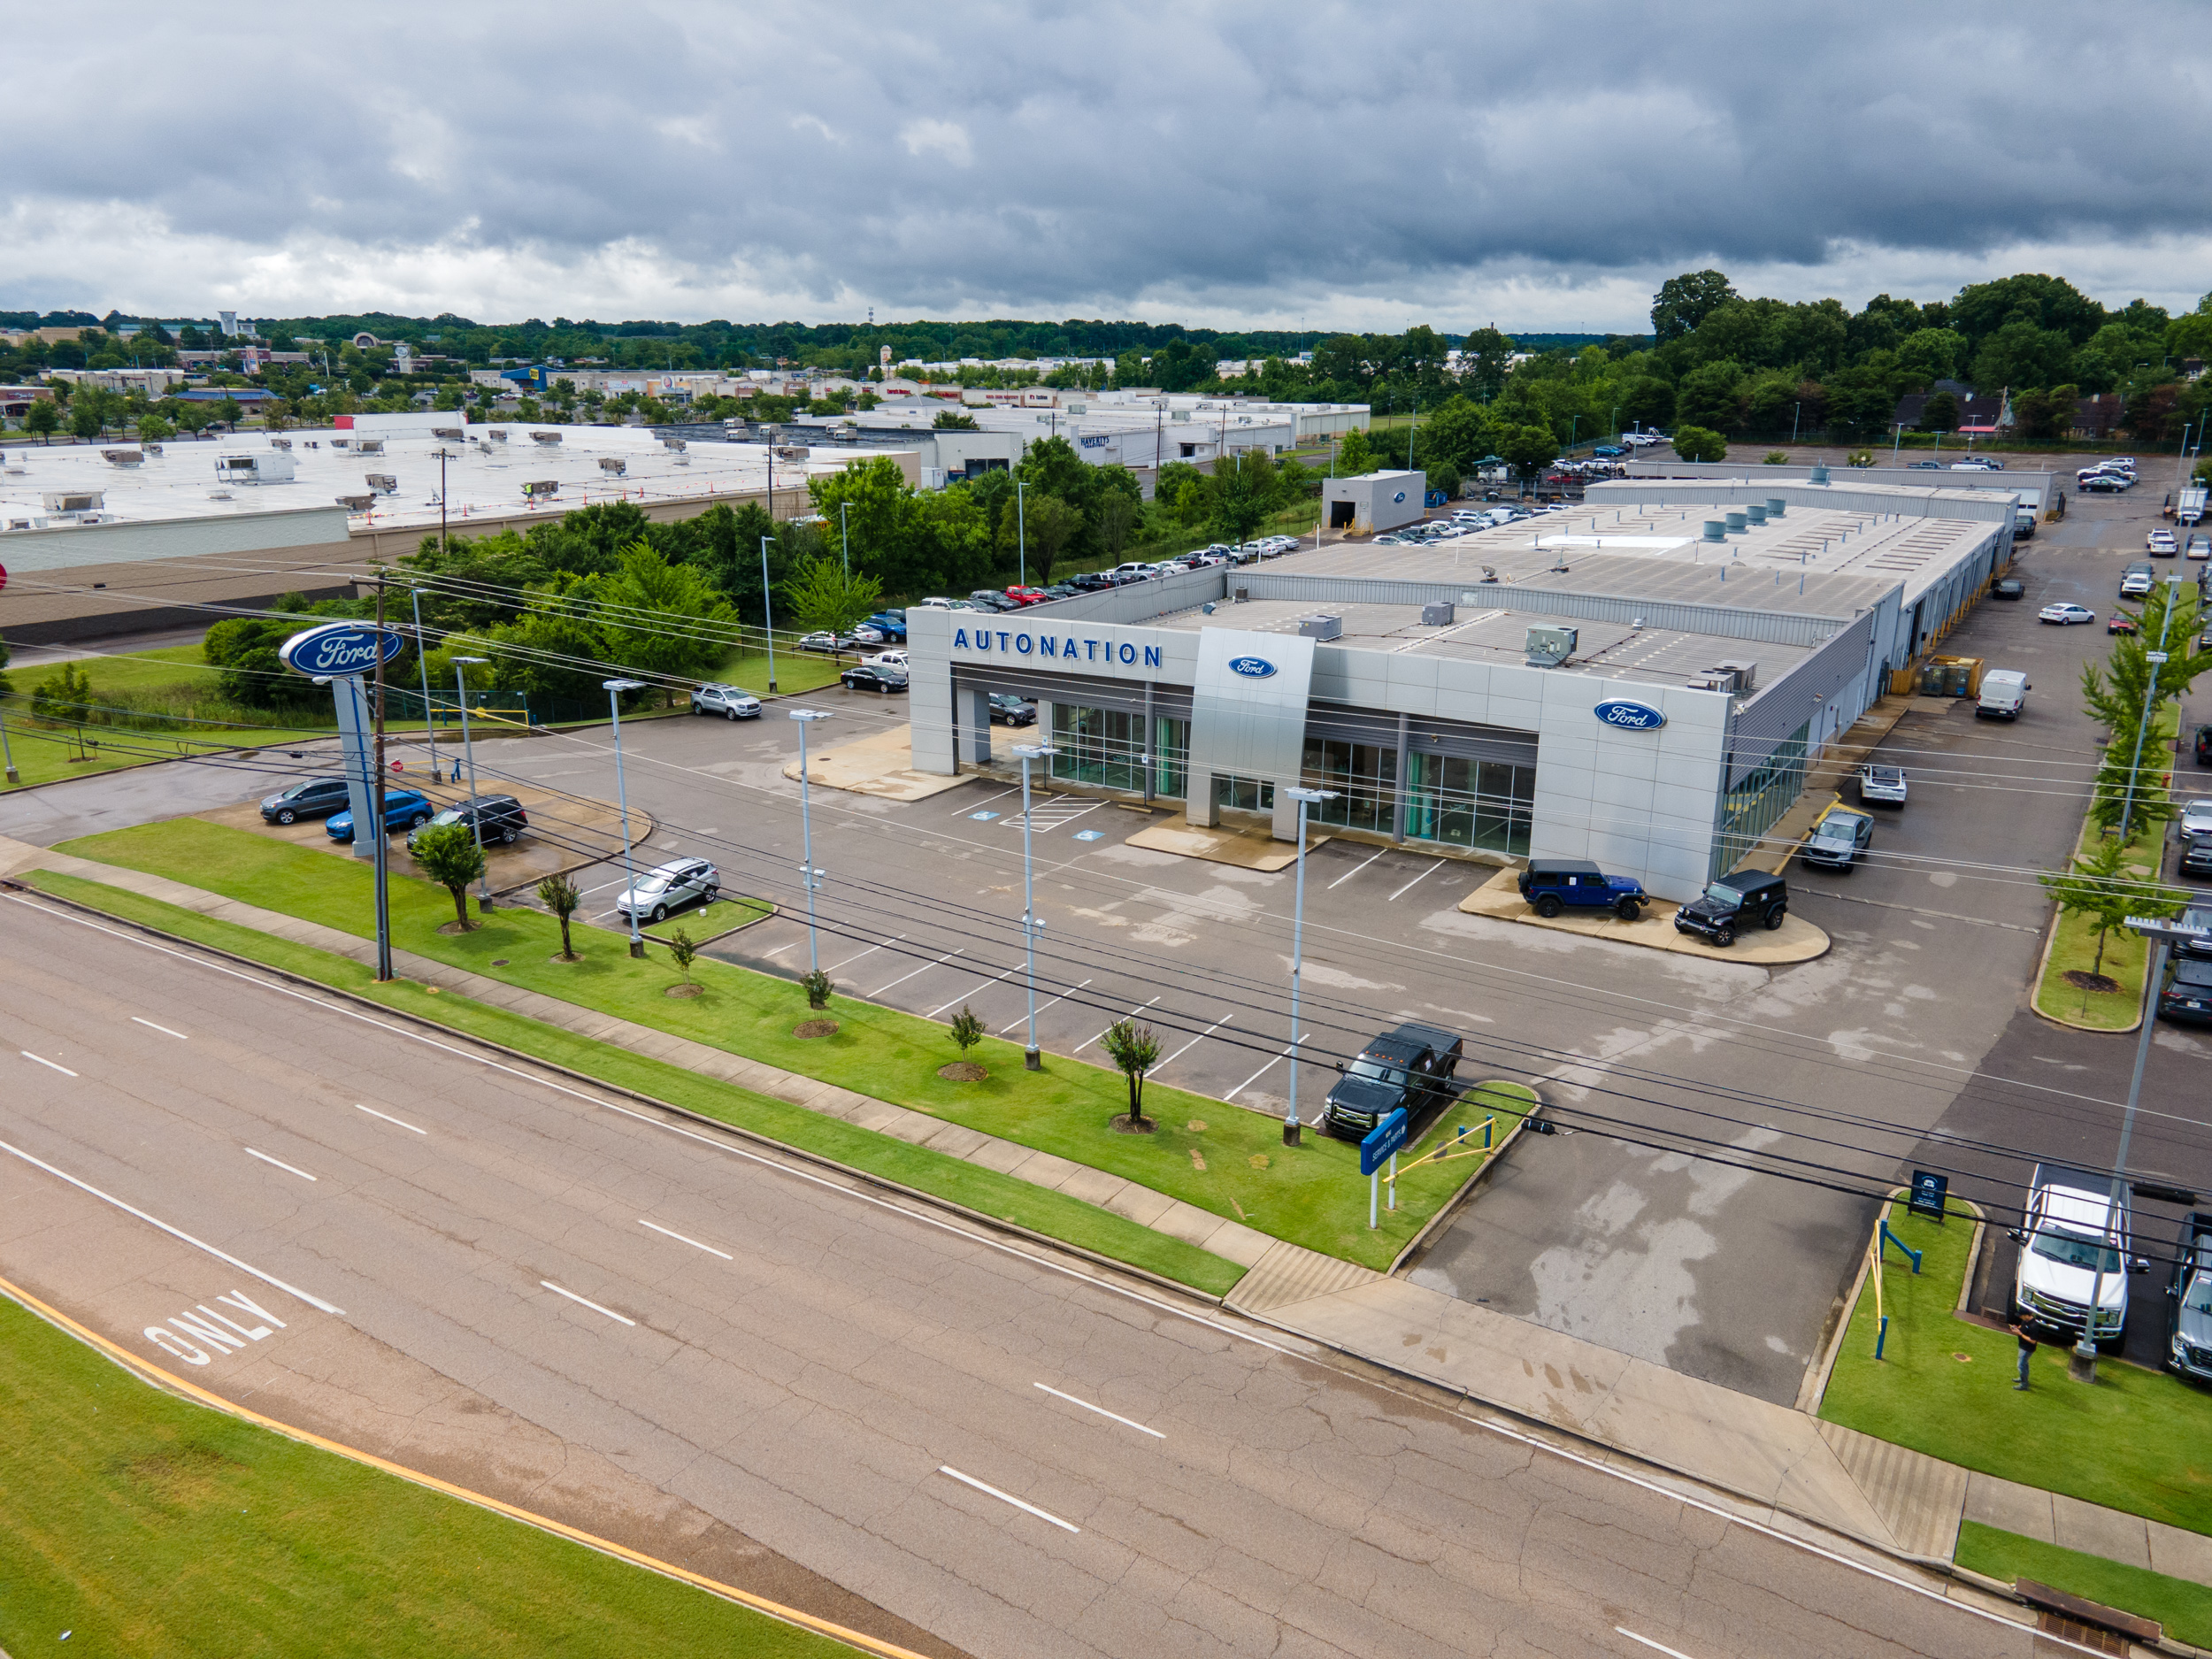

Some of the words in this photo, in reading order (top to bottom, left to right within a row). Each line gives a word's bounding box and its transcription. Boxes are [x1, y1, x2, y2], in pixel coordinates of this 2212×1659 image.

[1080, 435, 1110, 446] HAVERTYS
[316, 634, 379, 668] Ford
[954, 627, 1162, 668] AUTONATION
[1237, 659, 1264, 674] Ford
[1607, 705, 1648, 726] Ford
[1372, 1141, 1387, 1162] SERVICE
[143, 1289, 288, 1365] ONLY
